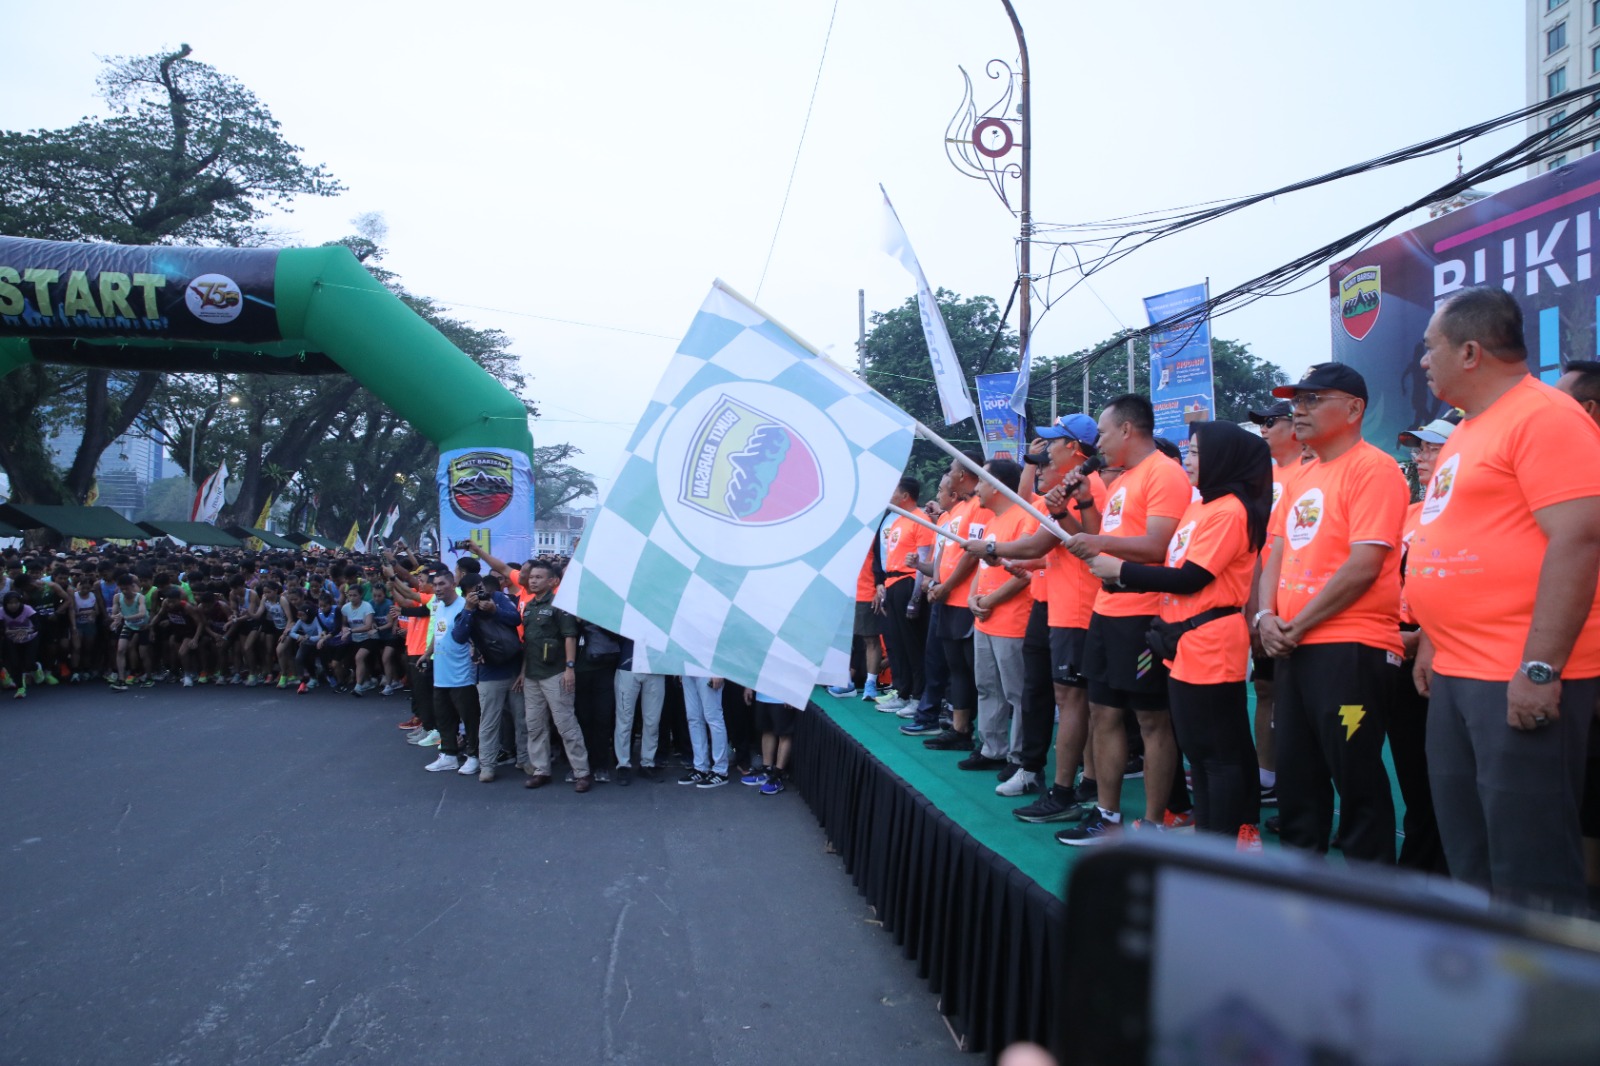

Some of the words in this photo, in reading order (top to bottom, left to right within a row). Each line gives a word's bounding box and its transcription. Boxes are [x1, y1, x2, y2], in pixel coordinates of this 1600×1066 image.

[1434, 207, 1600, 313] BUKI
[0, 266, 166, 319] START
[477, 459, 507, 469] BARISAN
